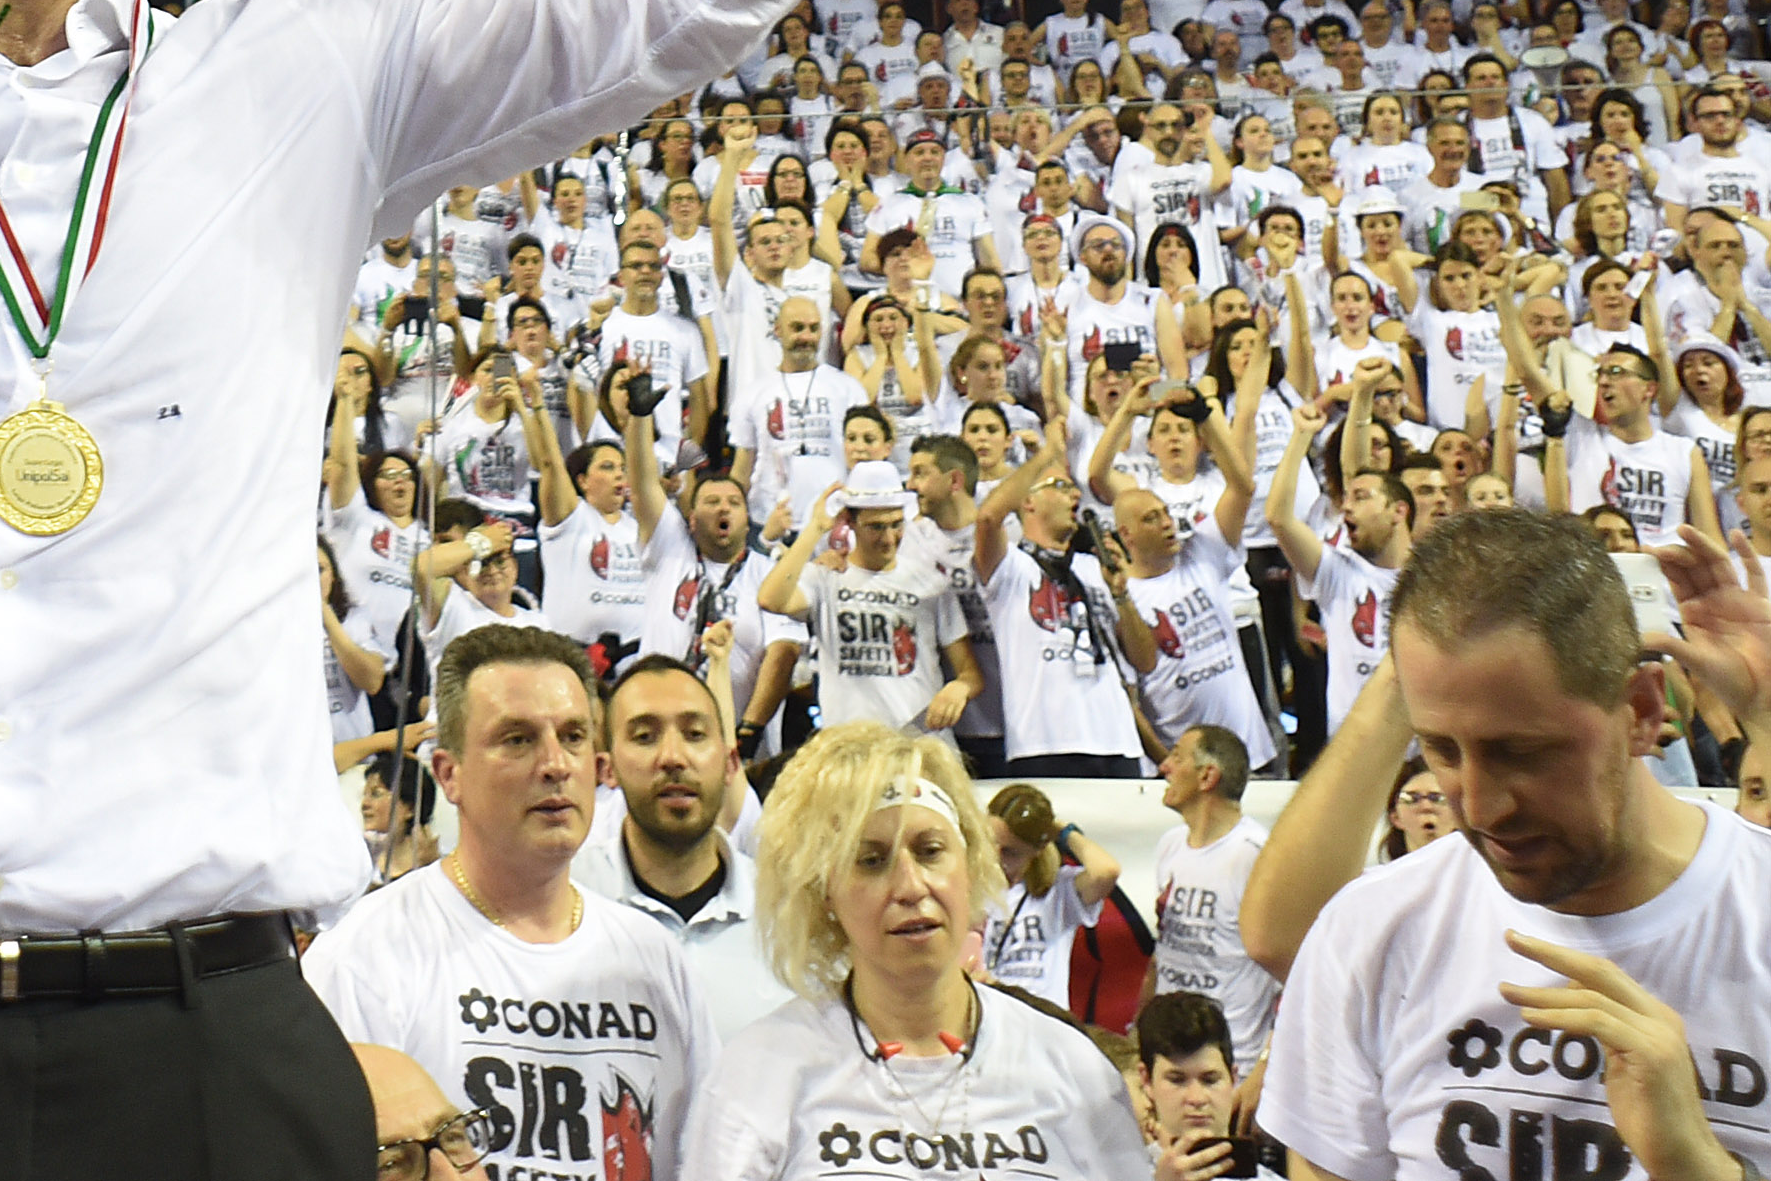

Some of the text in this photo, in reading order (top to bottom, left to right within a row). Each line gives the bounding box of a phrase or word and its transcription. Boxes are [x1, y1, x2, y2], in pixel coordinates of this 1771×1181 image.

[1153, 192, 1187, 214] SIR
[1707, 184, 1741, 202] SIR
[633, 339, 671, 357] SIR
[1617, 466, 1665, 497] SIR
[1169, 587, 1215, 627] SIR
[837, 611, 890, 644] SIR
[839, 646, 891, 661] SAFETY
[1172, 887, 1218, 919] SIR
[501, 998, 658, 1041] CONAD
[1509, 1026, 1768, 1108] COD
[464, 1056, 596, 1162] SIR
[868, 1124, 1048, 1171] CONAD
